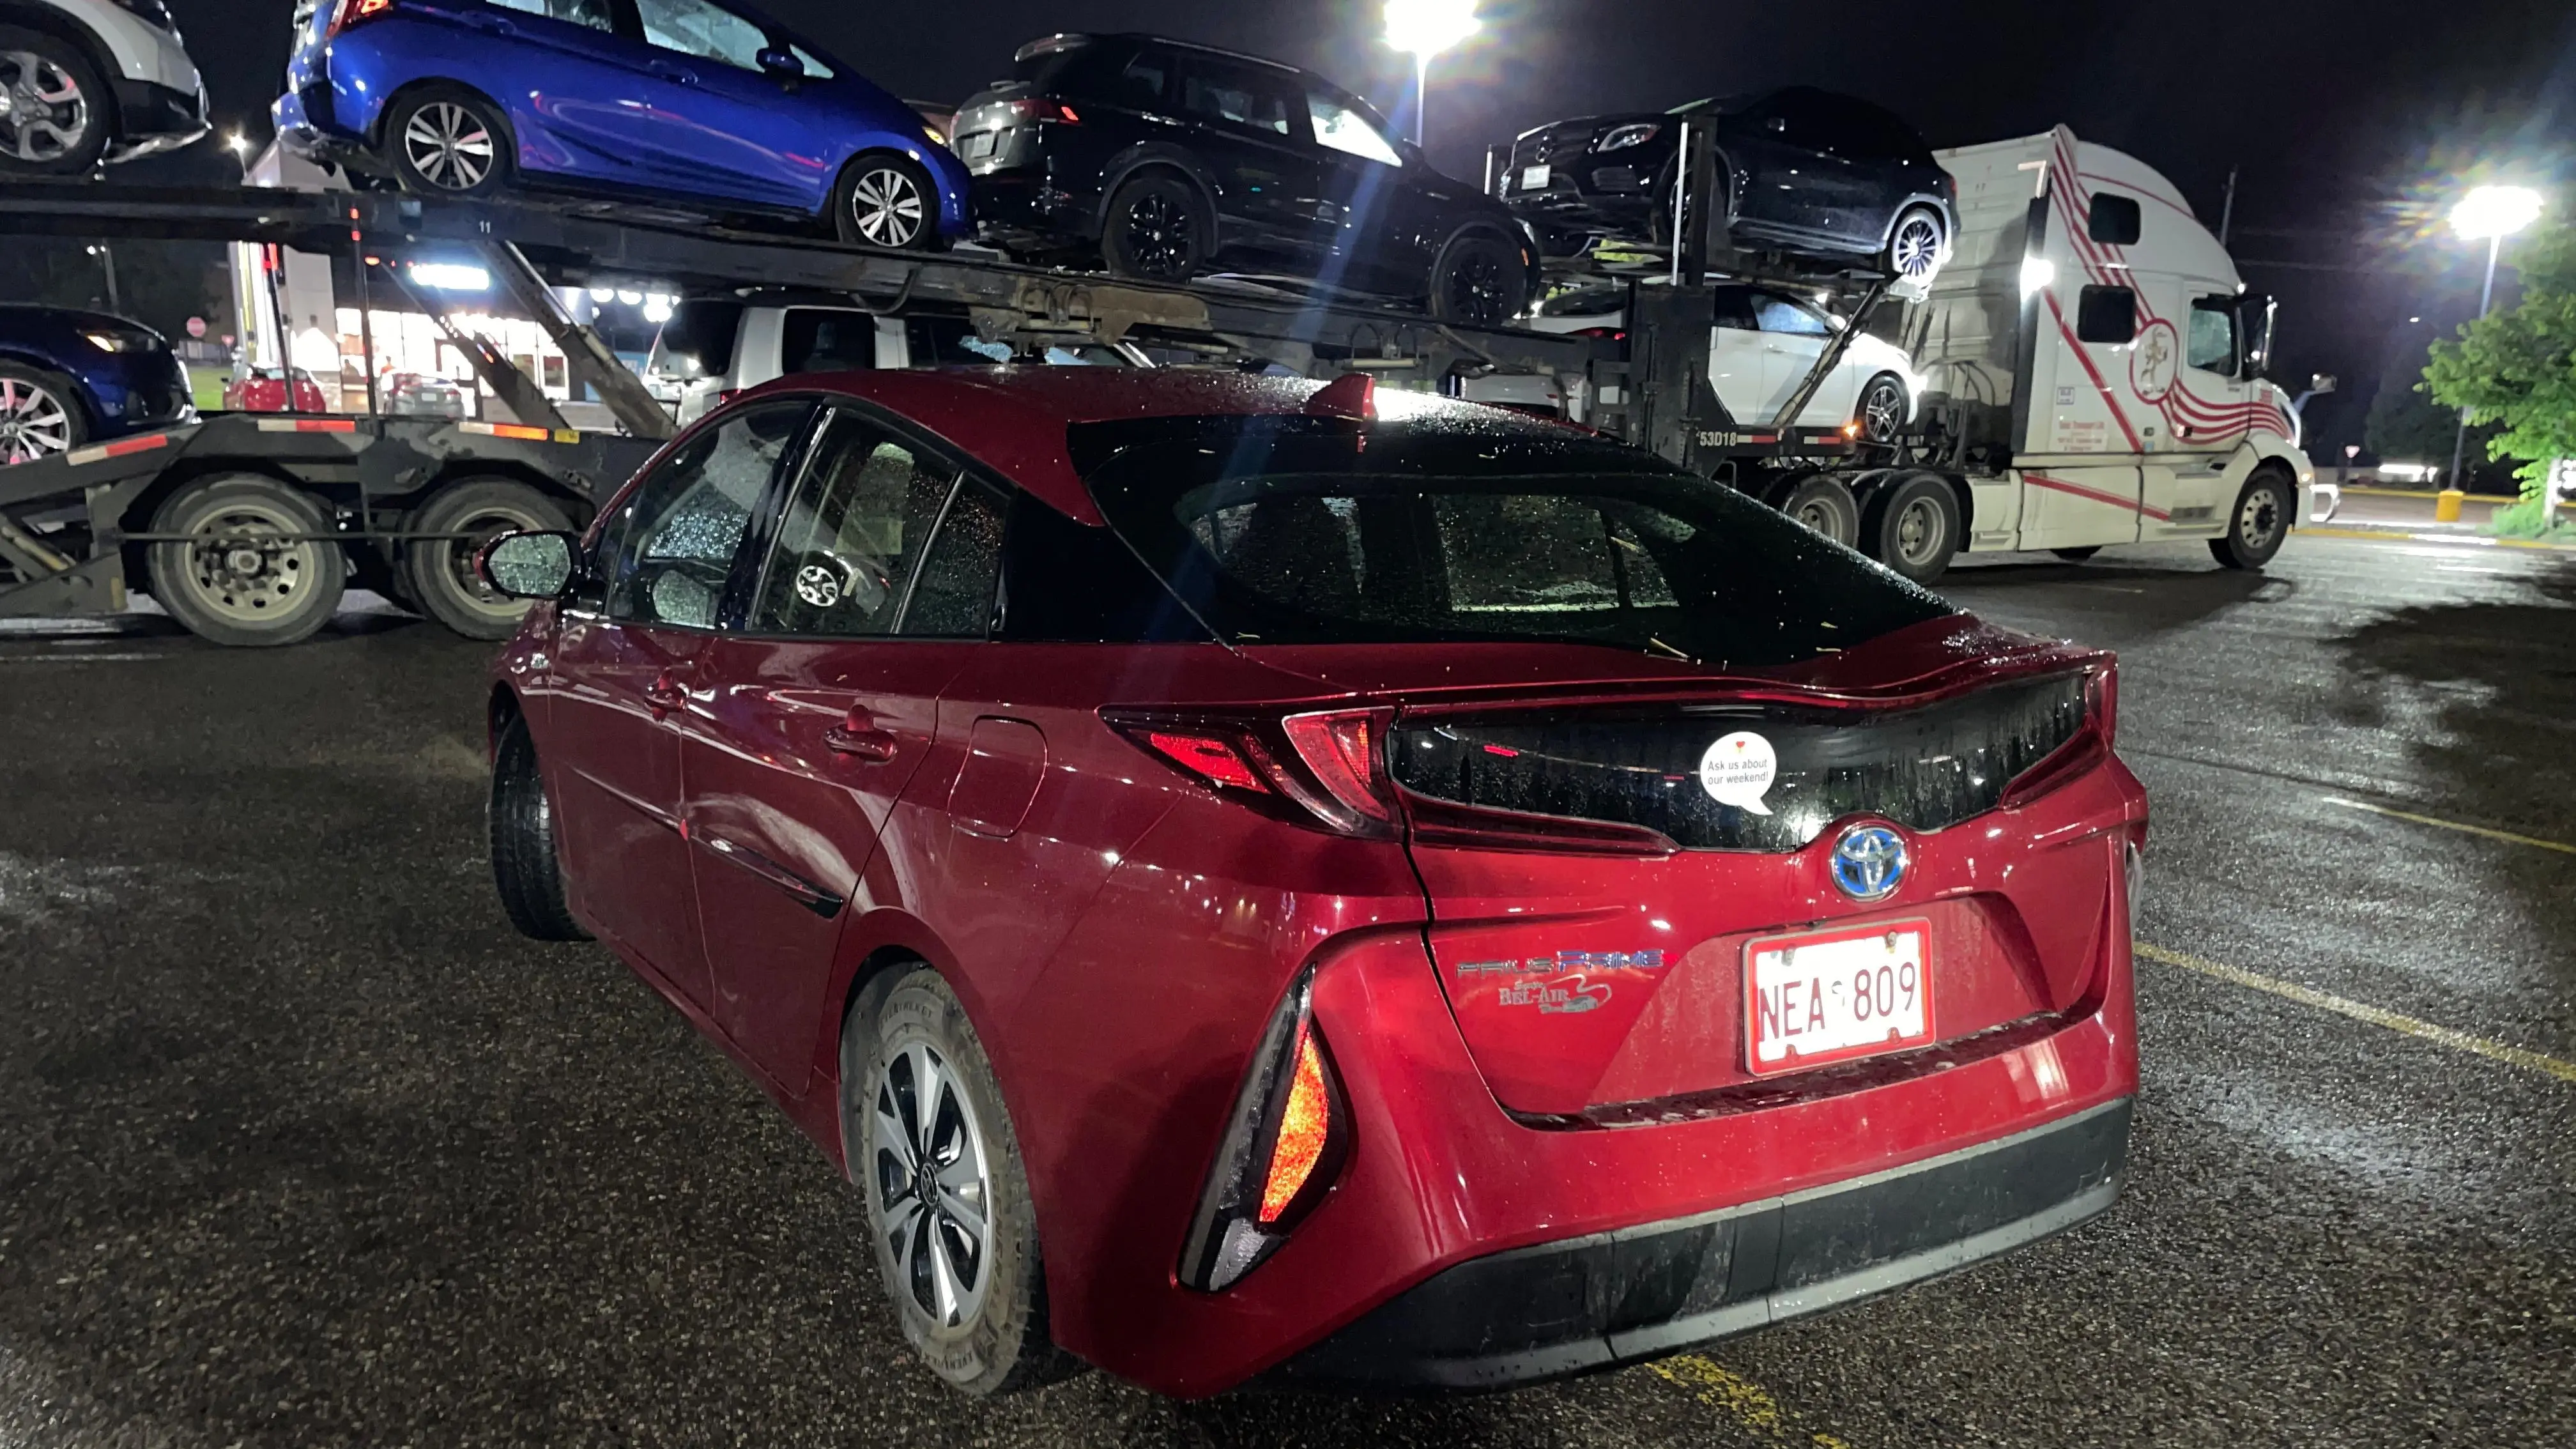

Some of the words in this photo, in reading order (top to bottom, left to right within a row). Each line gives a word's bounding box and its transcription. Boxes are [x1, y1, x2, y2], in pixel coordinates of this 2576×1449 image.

[1699, 431, 1736, 447] 53D18
[1708, 760, 1725, 771] Ask
[1728, 761, 1739, 770] us
[1742, 759, 1767, 769] about
[1708, 776, 1724, 785] our
[1726, 771, 1768, 784] weekend!
[1758, 977, 1825, 1042] NEA
[1854, 962, 1916, 1022] 809
